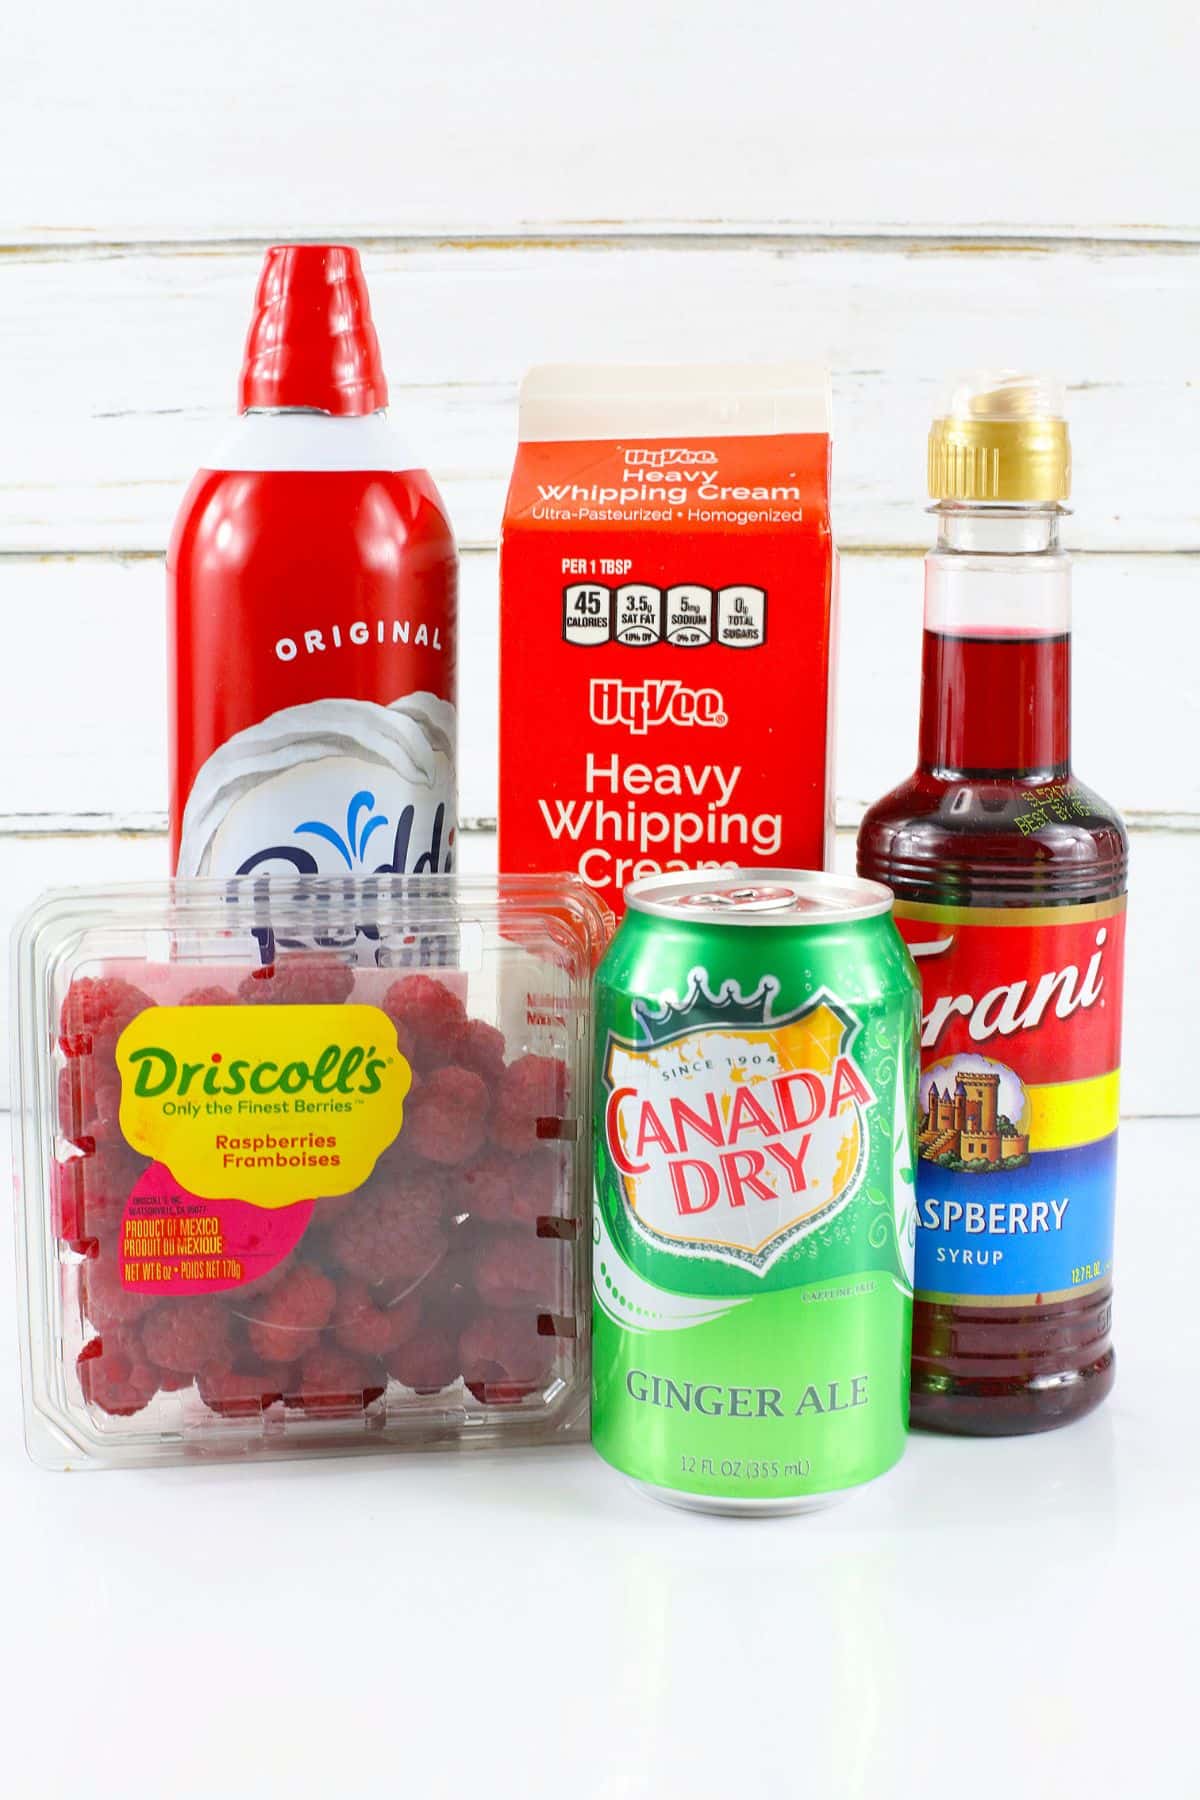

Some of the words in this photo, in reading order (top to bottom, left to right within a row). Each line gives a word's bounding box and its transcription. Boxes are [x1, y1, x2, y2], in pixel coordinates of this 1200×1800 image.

[622, 469, 718, 485] Heavy
[537, 485, 687, 504] Whipping
[698, 484, 800, 501] Cream
[531, 508, 672, 522] Ultra-Pasteurized
[687, 508, 802, 525] Homogenized
[561, 558, 587, 574] PER
[591, 559, 595, 574] 1
[600, 559, 632, 575] TBSP
[574, 591, 601, 615] 45
[680, 596, 701, 613] 5mg
[566, 616, 608, 628] CALORIES
[621, 614, 638, 624] SAT
[641, 614, 656, 625] FAT
[671, 614, 707, 625] SODIUM
[728, 616, 754, 626] TOTAL
[275, 621, 442, 661] ORIGINAL
[722, 628, 759, 640] SUGARS
[585, 753, 741, 807] Heavy
[538, 799, 782, 855] Whipping
[1013, 806, 1053, 836] BEST
[907, 927, 1107, 1047] rani
[129, 1045, 386, 1097] Driscoll's
[661, 1060, 714, 1082] SINCE
[727, 1055, 777, 1067] 1904
[162, 1102, 201, 1118] Only
[206, 1102, 233, 1114] the
[238, 1100, 289, 1114] Finest
[295, 1099, 352, 1113] Berries
[606, 1057, 873, 1174] CANADA
[216, 1133, 337, 1152] Raspberries
[223, 1152, 341, 1168] Framboises
[668, 1133, 812, 1215] DRY
[915, 1198, 1069, 1235] SPBERRY
[126, 1219, 165, 1237] PRODUCT
[167, 1219, 177, 1235] OF
[180, 1217, 218, 1236] MEXICO
[124, 1238, 161, 1256] PRODUIT
[164, 1238, 175, 1256] DU
[178, 1237, 222, 1255] MEXIQUE
[937, 1247, 1003, 1265] SYRUP
[125, 1263, 139, 1280] NET
[142, 1263, 155, 1280] WT
[156, 1263, 161, 1280] 6
[181, 1261, 204, 1280] POIDS
[206, 1260, 220, 1279] NET
[223, 1260, 240, 1280] 170g
[626, 1369, 784, 1417] GINGER
[794, 1374, 869, 1416] ALE
[680, 1455, 696, 1473] 12
[701, 1458, 716, 1475] FL
[721, 1460, 742, 1477] OZ
[746, 1461, 779, 1480] (355
[784, 1460, 811, 1478] mL)
